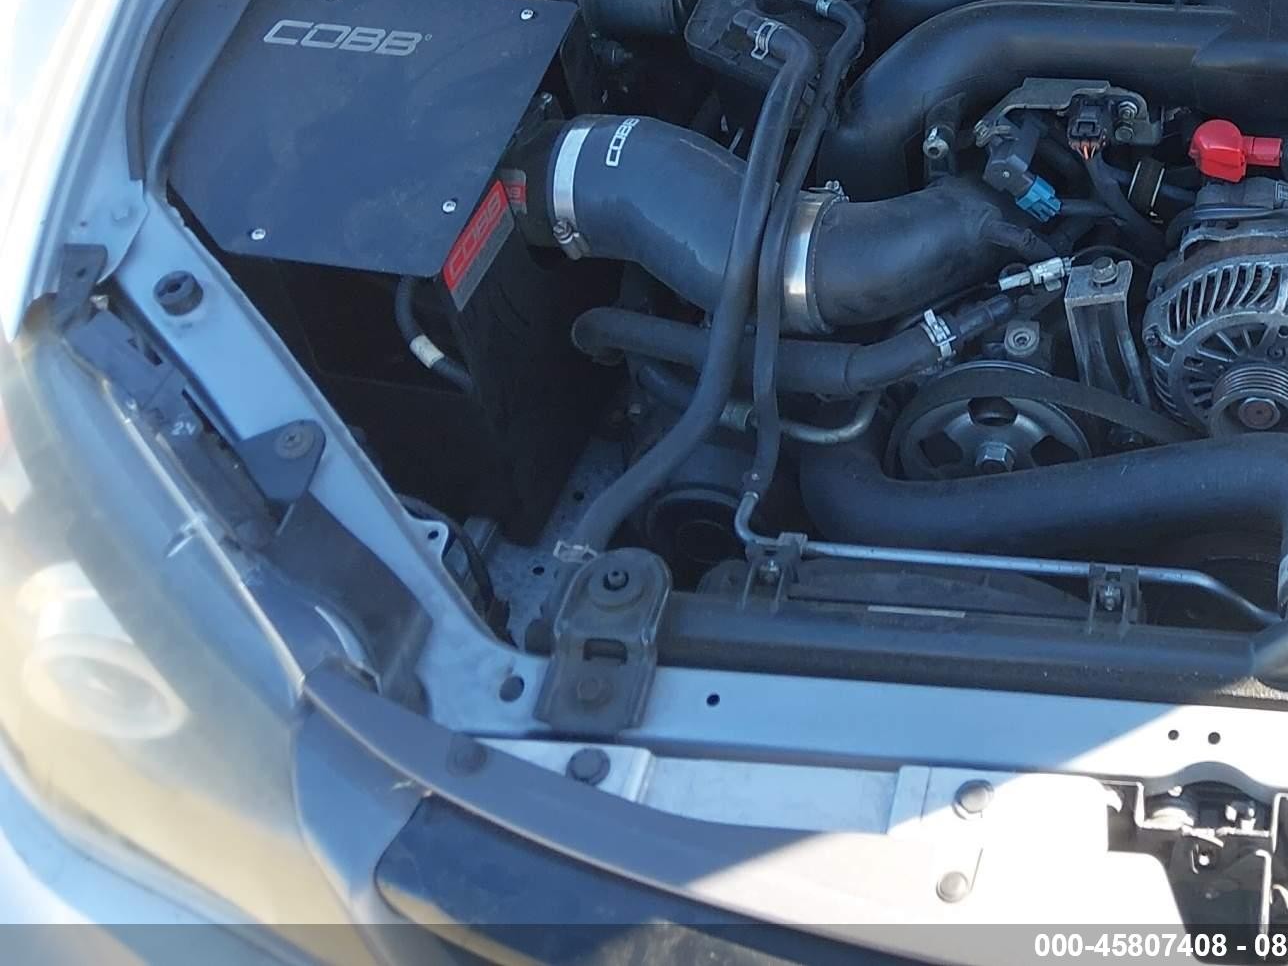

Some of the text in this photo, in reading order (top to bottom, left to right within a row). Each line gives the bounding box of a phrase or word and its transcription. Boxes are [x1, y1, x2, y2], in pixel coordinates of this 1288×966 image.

[263, 19, 423, 56] COBB
[606, 118, 640, 167] COBB
[450, 192, 501, 283] COBB
